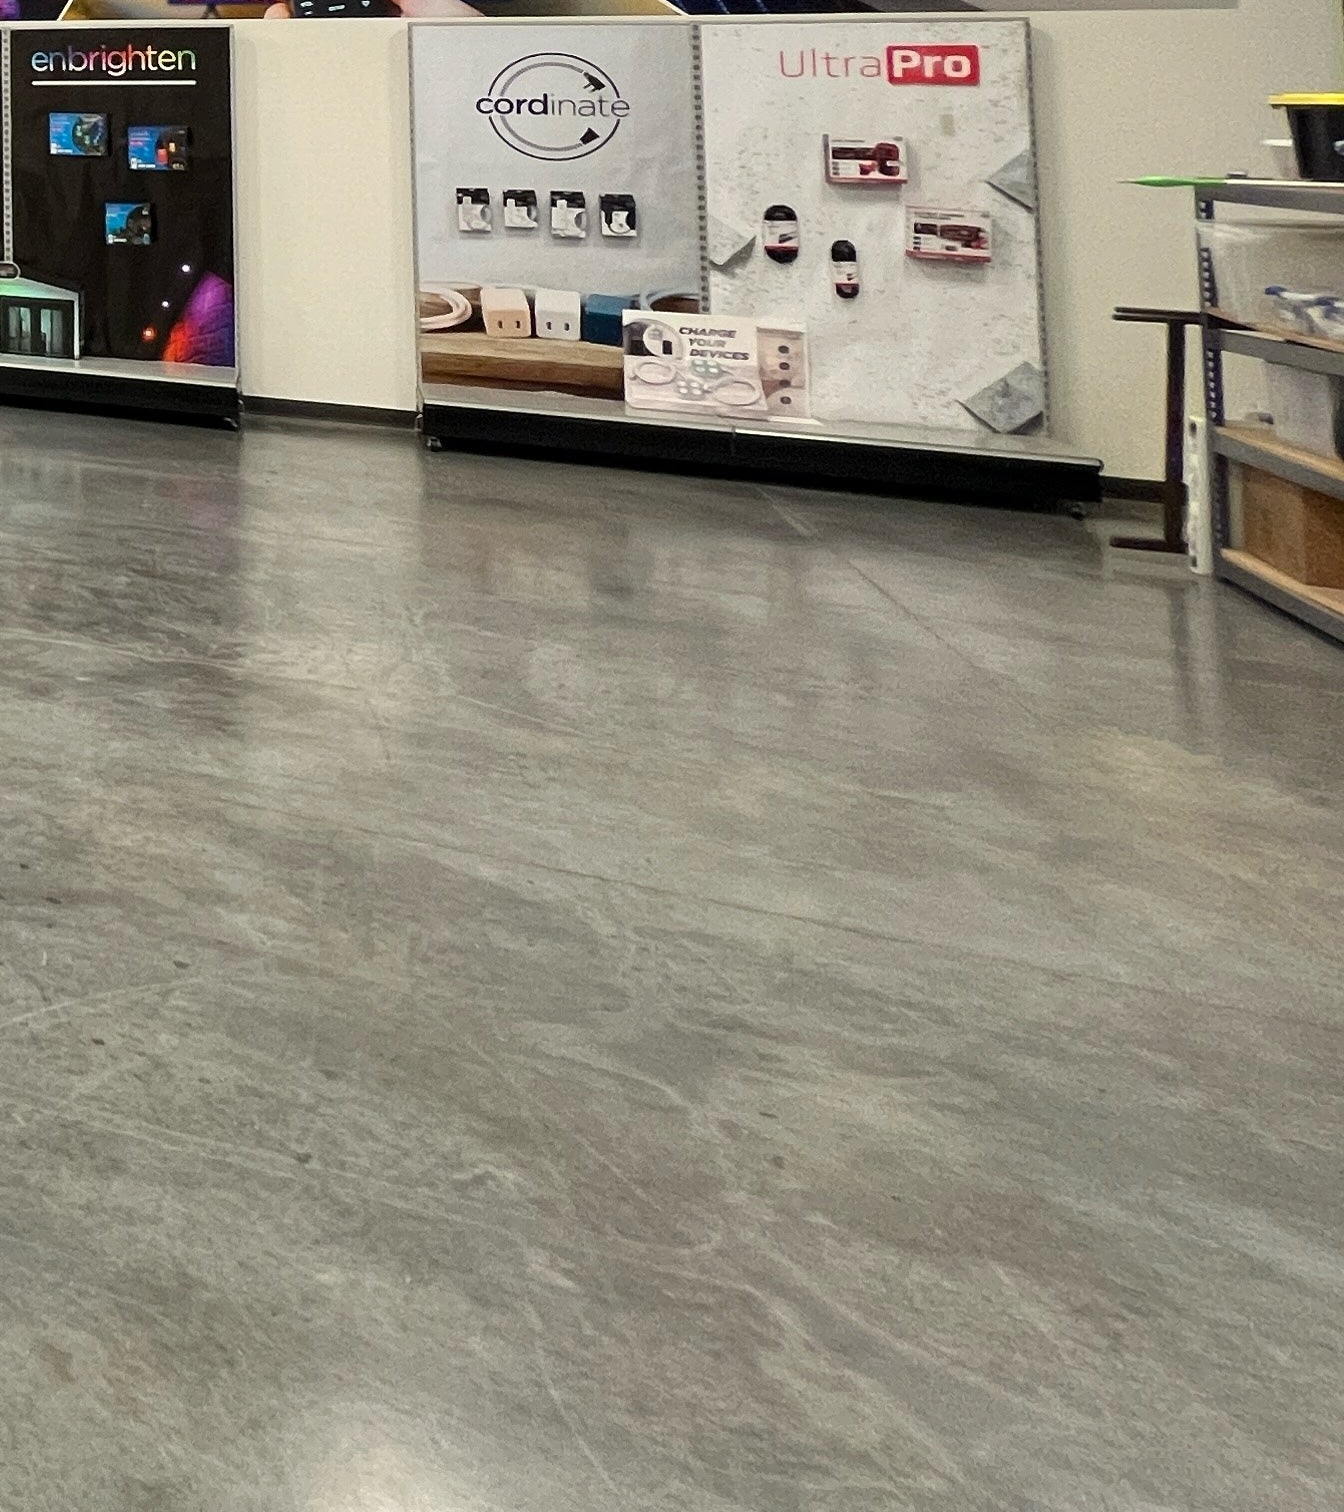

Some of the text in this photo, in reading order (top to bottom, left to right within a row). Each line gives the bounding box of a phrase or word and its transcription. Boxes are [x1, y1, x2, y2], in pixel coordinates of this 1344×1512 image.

[31, 43, 197, 77] enbrighten
[475, 92, 631, 118] cordinate
[689, 348, 750, 361] DEVICES
